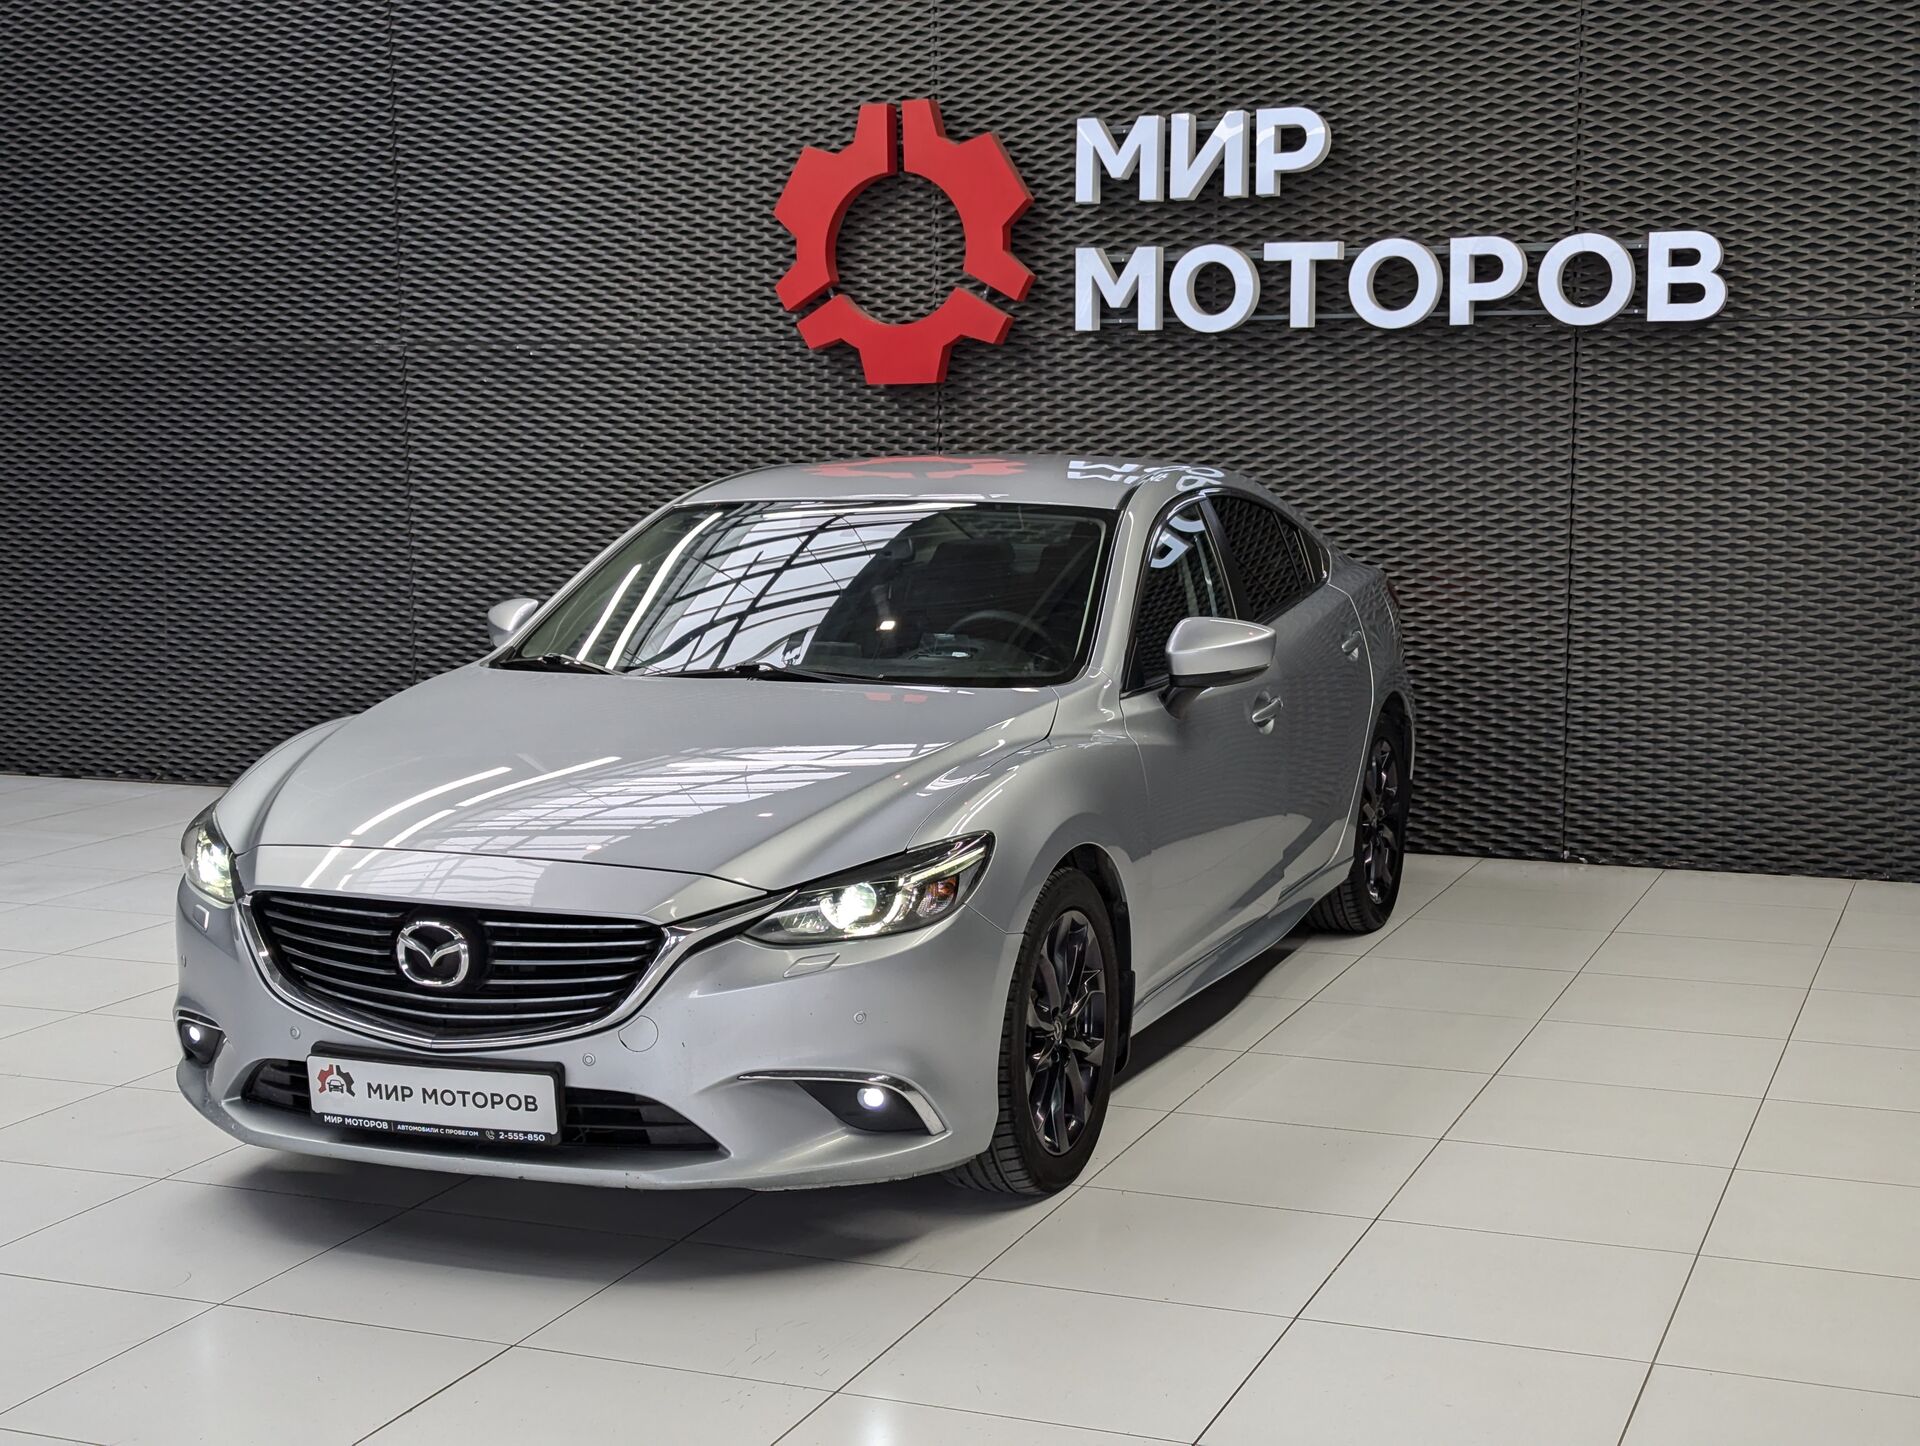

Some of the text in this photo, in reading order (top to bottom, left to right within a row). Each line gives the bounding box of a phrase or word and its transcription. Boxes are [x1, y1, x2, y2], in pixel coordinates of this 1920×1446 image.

[1074, 107, 1331, 204] МИР
[1074, 230, 1728, 333] МОТОРОВ
[366, 1082, 538, 1112] МИР МОТОРОВ
[324, 1115, 389, 1130] МИР МОТОРОВ
[397, 1124, 439, 1134] АВТОМОБИЛИ
[445, 1127, 479, 1137] ПРОБЕГОМ
[498, 1132, 546, 1142] 2-555-850
